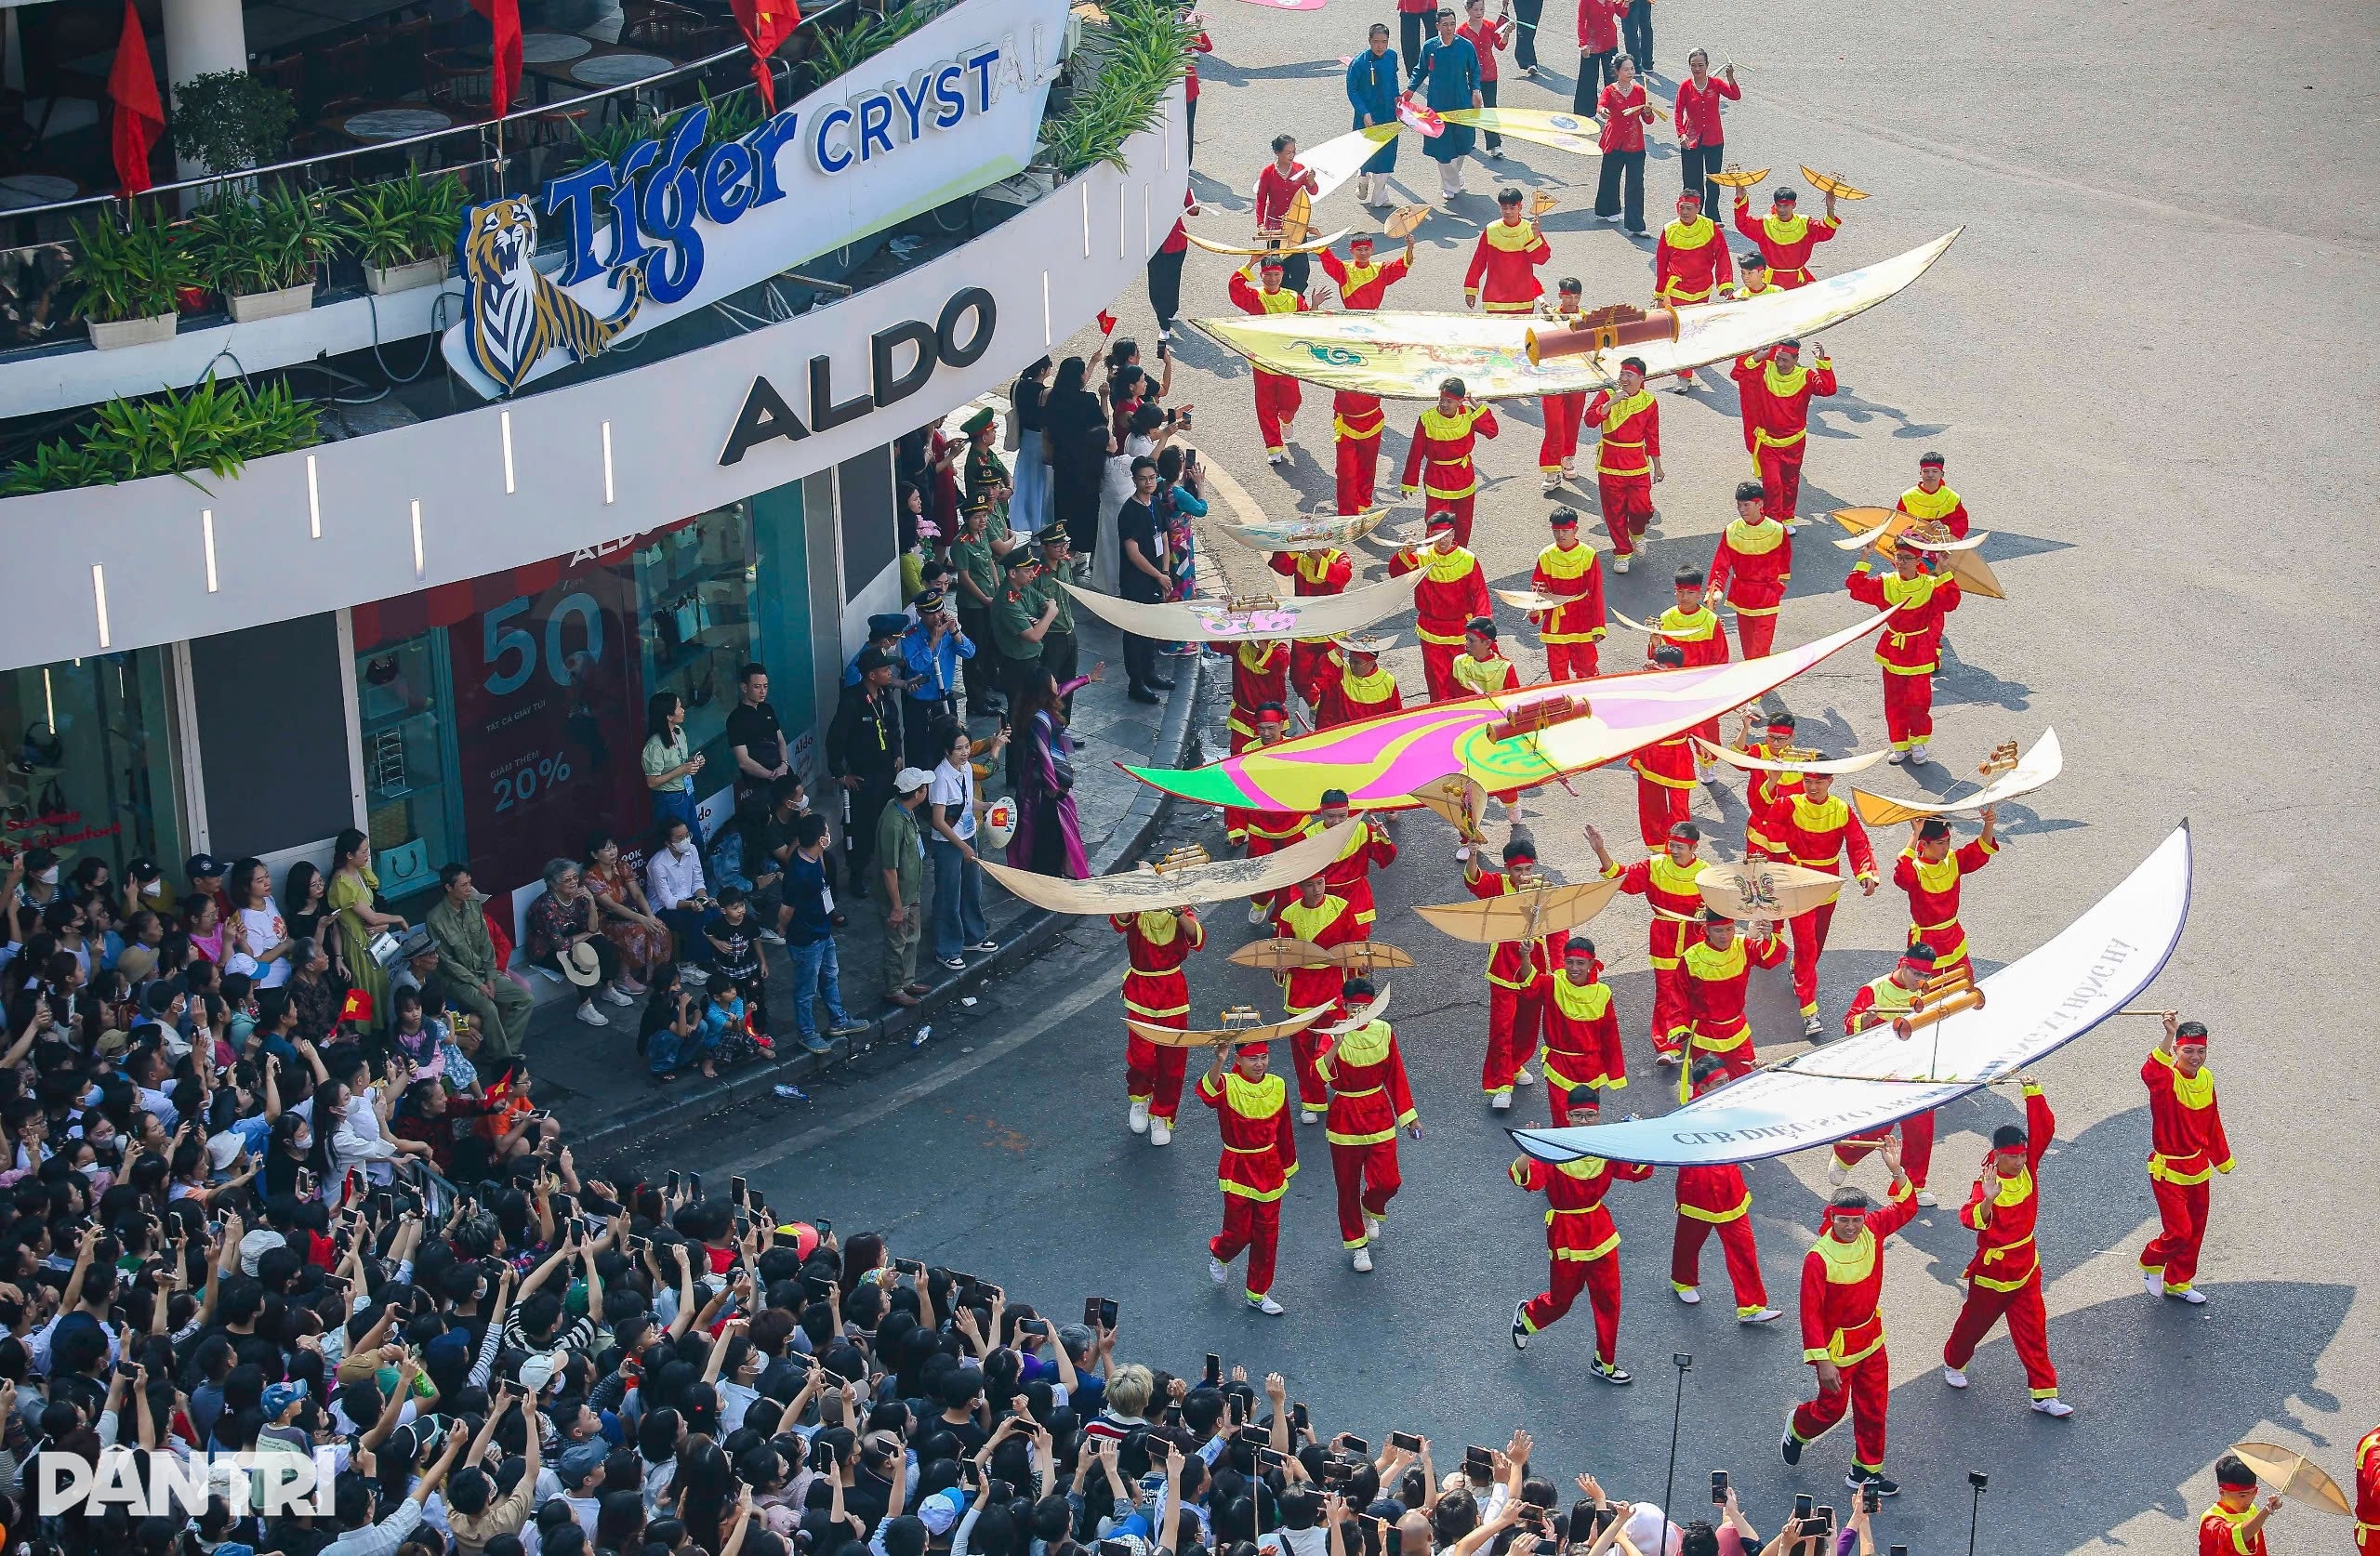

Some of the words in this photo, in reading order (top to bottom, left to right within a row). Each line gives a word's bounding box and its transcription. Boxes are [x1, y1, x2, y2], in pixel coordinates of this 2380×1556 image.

[543, 105, 799, 304] Tiger
[718, 286, 997, 466] ALDO
[569, 531, 654, 568] ALD
[483, 593, 603, 695] 50
[794, 734, 813, 757] Aldo
[493, 751, 571, 812] 20%
[621, 850, 641, 862] OOK
